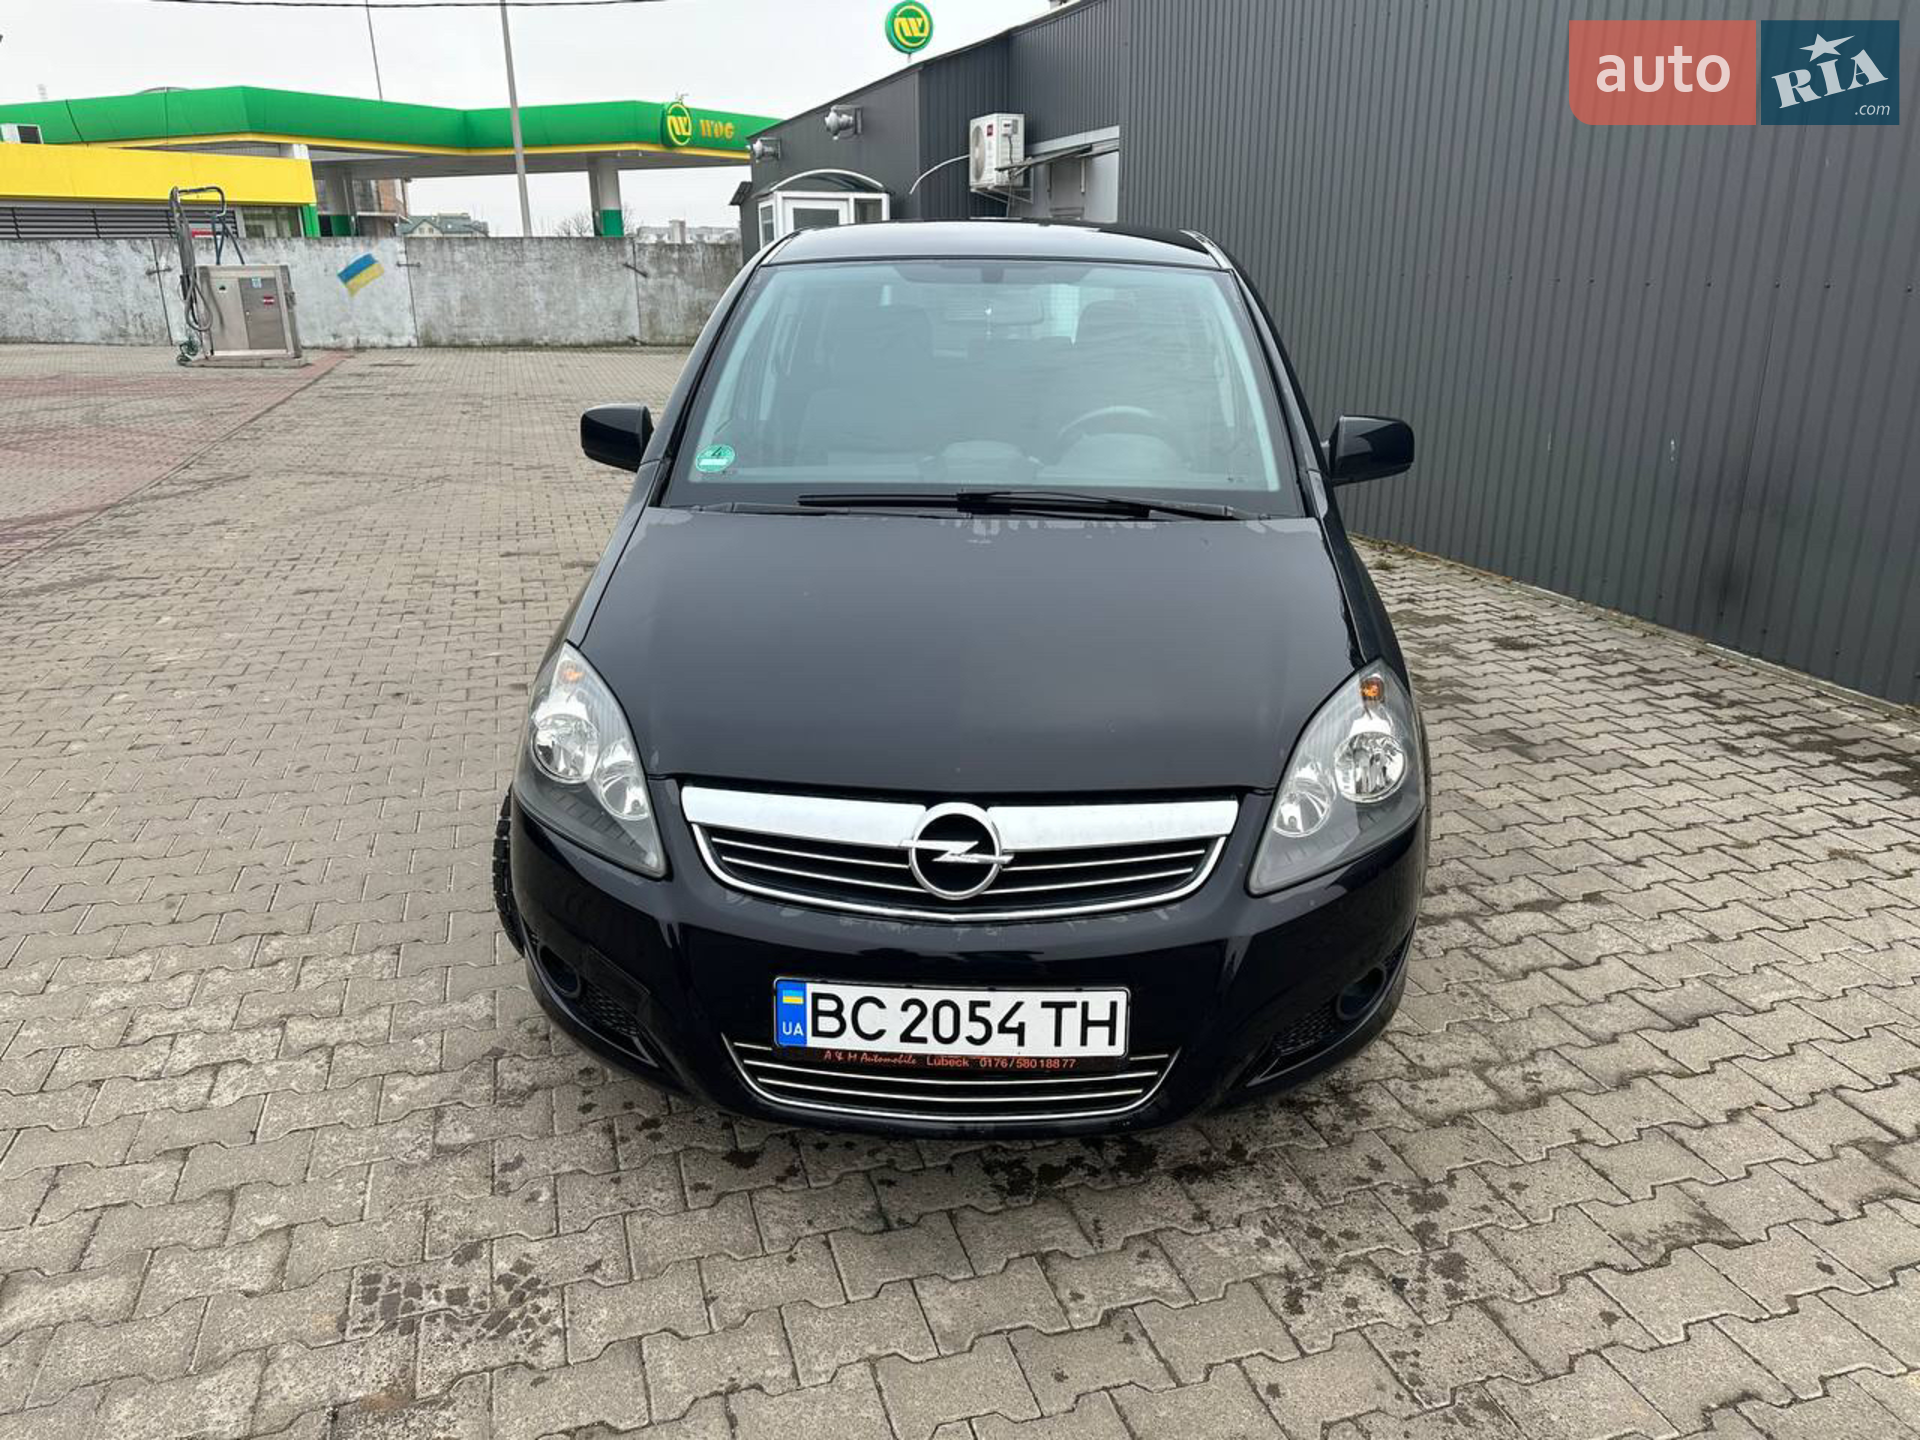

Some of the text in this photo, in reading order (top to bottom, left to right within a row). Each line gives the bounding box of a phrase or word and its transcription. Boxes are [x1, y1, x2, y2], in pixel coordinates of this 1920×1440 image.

[782, 1021, 804, 1036] UA
[811, 992, 1118, 1047] BC 2054 TH
